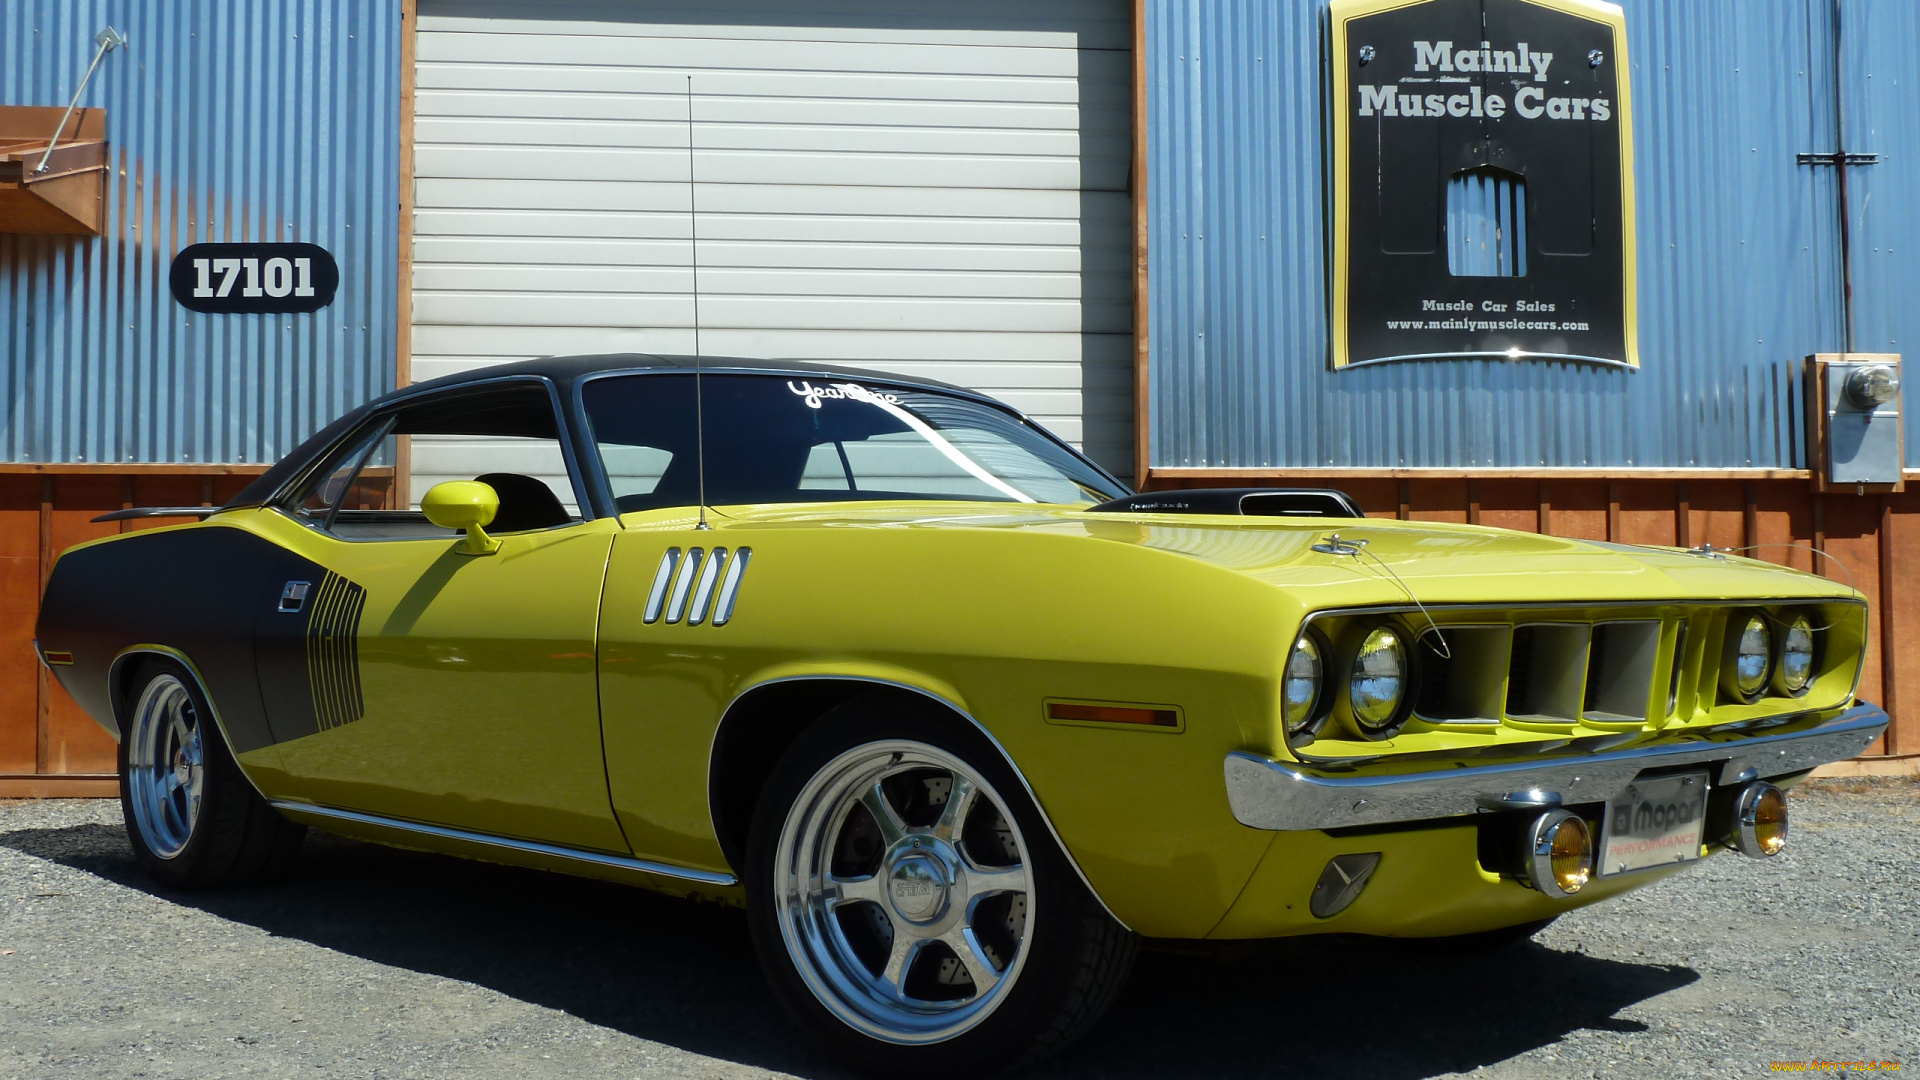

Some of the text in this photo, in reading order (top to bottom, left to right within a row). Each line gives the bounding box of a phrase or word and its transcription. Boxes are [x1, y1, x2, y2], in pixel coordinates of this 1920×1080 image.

[1413, 41, 1553, 82] Mainly
[1358, 85, 1611, 121] Muscle Cars
[193, 257, 315, 298] 17101
[1422, 299, 1556, 313] Muscle Car Sales
[1386, 317, 1590, 332] www.mainlymusclecars.com
[1609, 832, 1697, 857] PERFORMANCE
